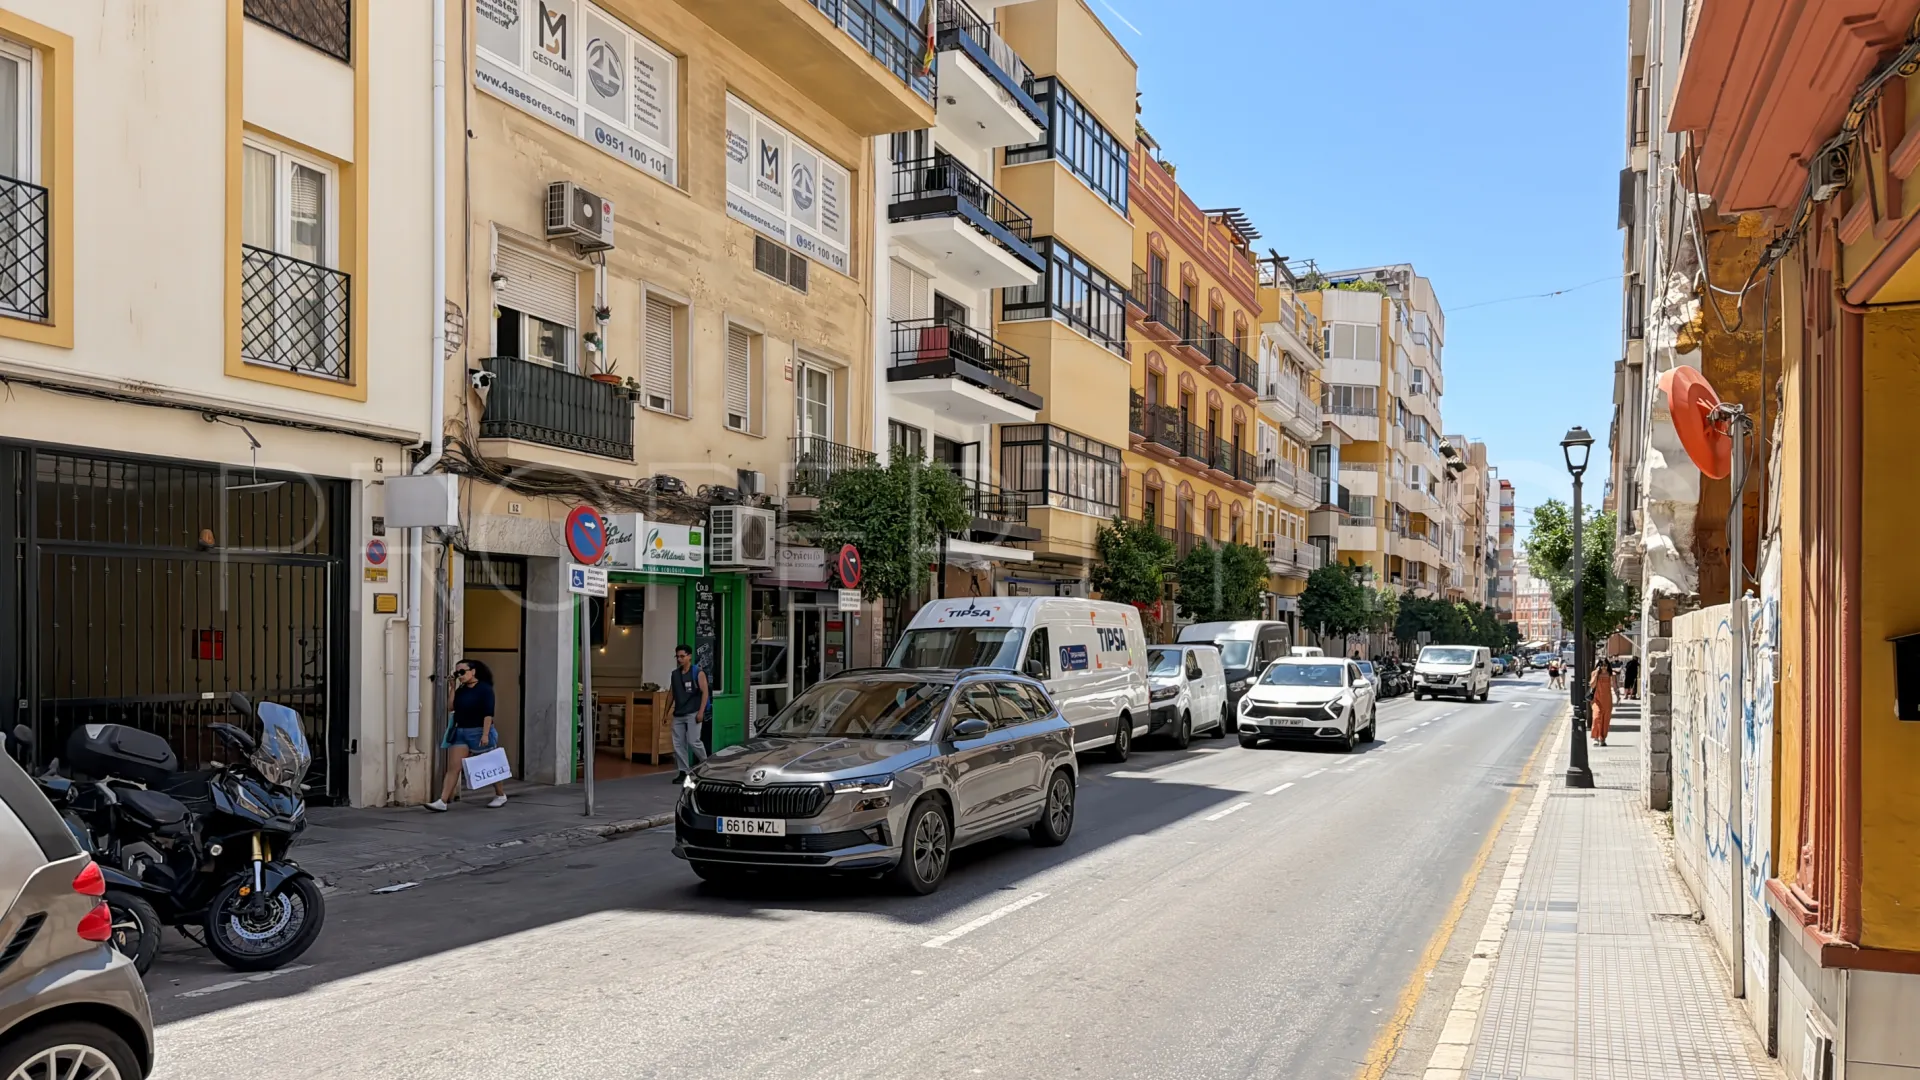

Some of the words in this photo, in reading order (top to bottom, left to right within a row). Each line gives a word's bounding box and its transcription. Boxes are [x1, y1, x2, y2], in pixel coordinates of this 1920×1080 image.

[532, 50, 573, 80] GESTORÍA
[605, 133, 624, 153] 951
[628, 145, 647, 165] 100
[649, 157, 668, 175] 101
[818, 245, 830, 260] 100
[948, 609, 991, 618] TIPSA
[1096, 627, 1127, 652] TIPSA
[474, 766, 505, 782] Sfera
[726, 819, 754, 833] 6616
[757, 821, 779, 834] MZL
